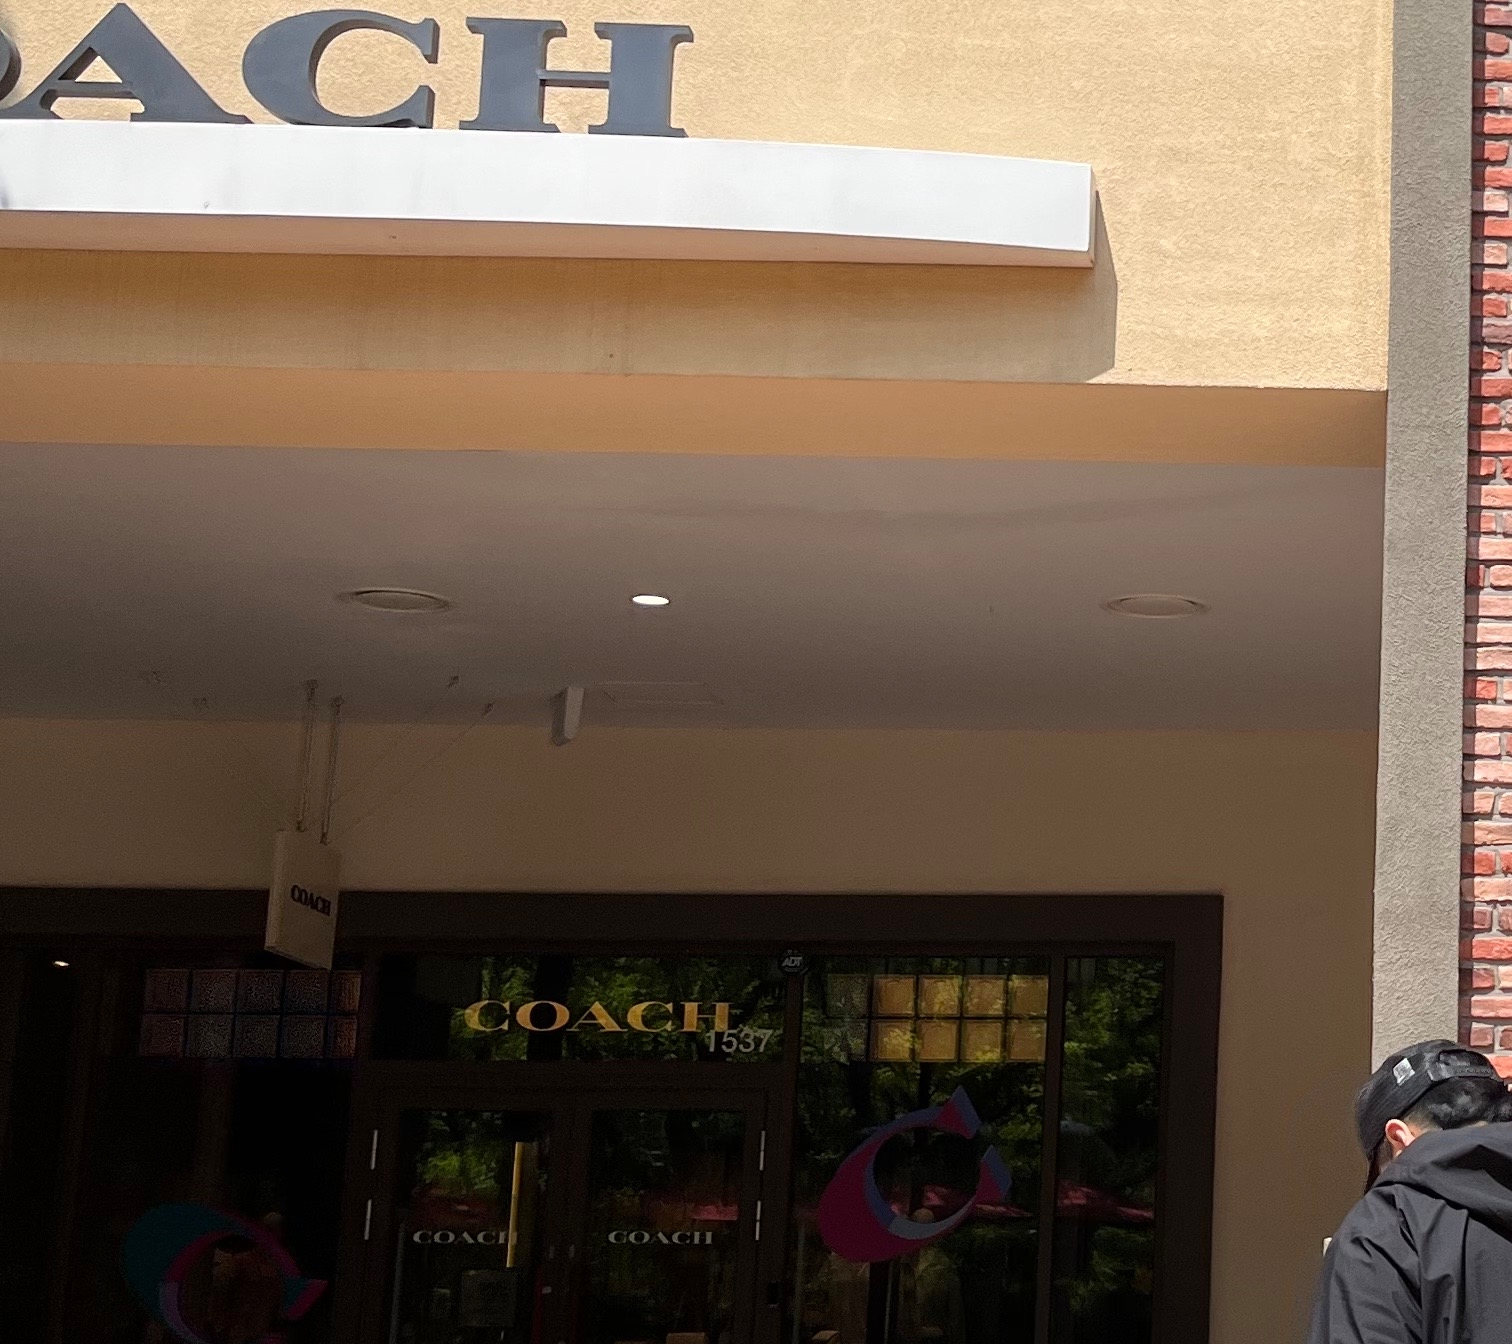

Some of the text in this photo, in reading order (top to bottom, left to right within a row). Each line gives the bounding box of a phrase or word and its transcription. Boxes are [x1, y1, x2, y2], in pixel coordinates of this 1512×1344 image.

[0, 2, 695, 138] ACH
[291, 884, 331, 916] COACH
[781, 956, 803, 967] ADT
[464, 999, 734, 1033] COACH
[705, 1028, 773, 1054] 1537
[412, 1230, 518, 1245] COACH
[607, 1230, 713, 1245] COACH
